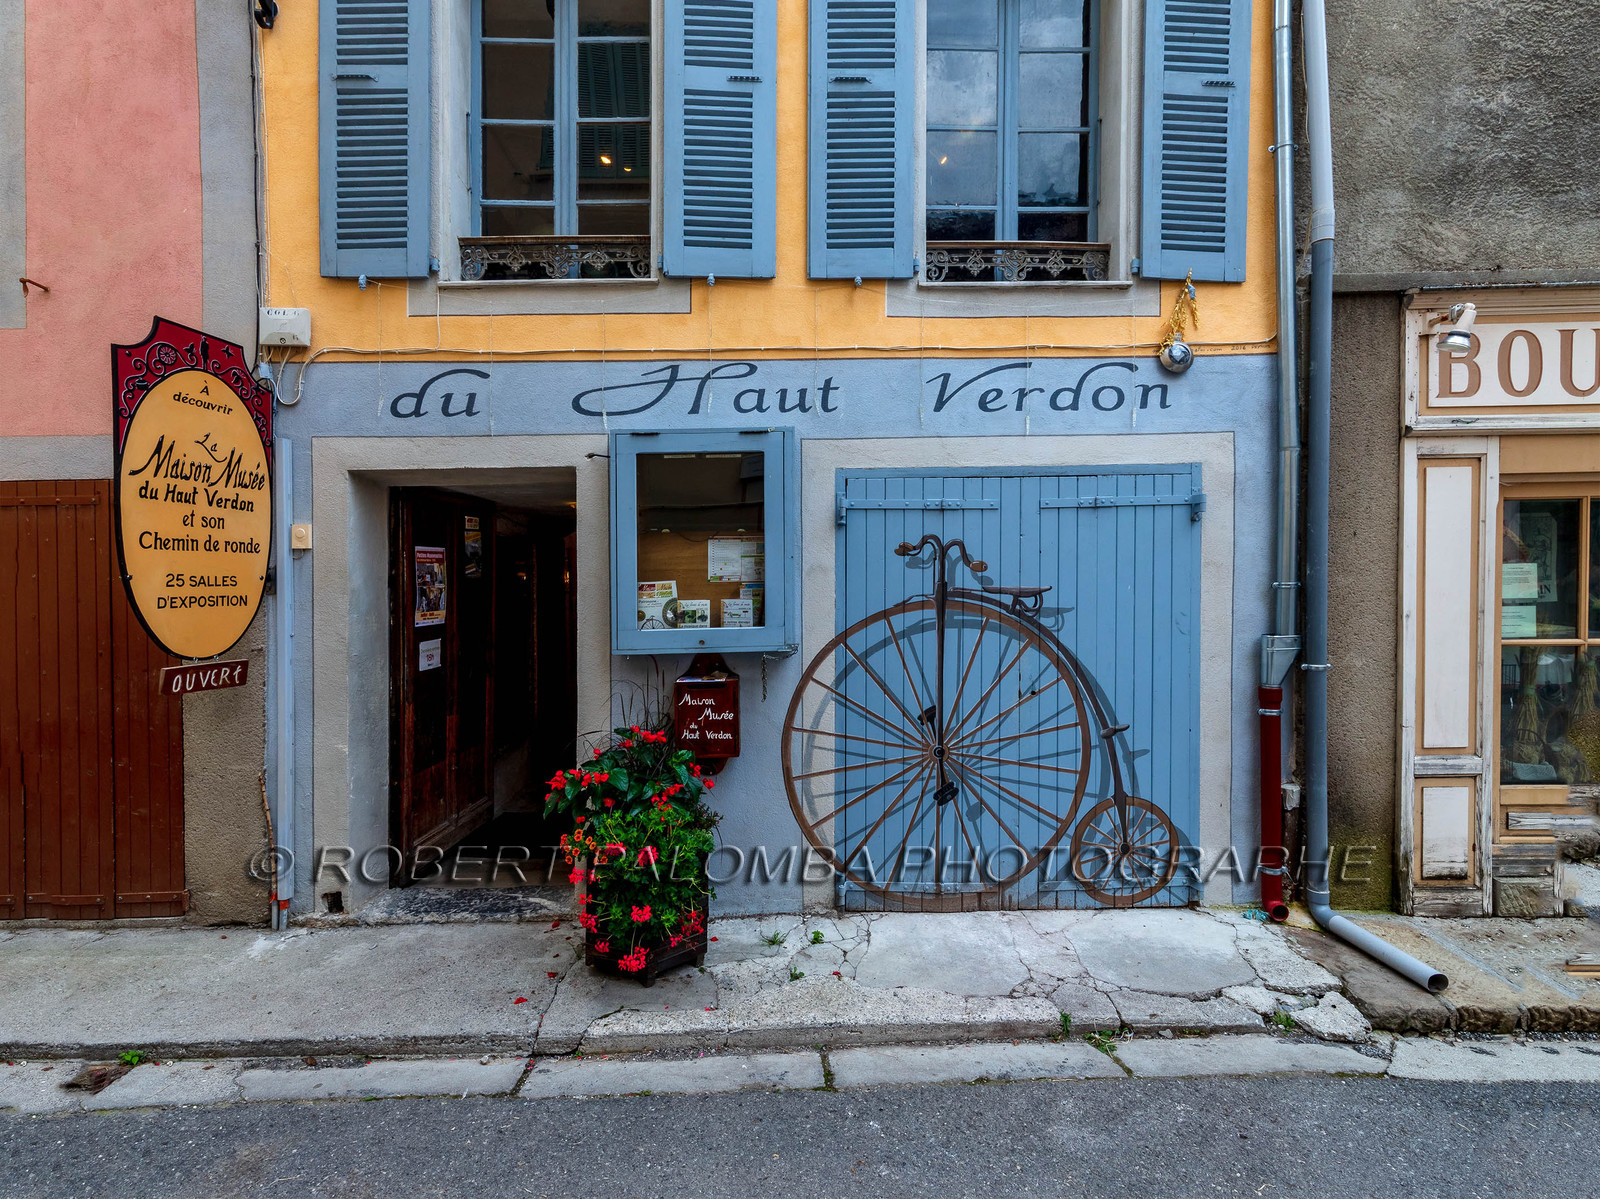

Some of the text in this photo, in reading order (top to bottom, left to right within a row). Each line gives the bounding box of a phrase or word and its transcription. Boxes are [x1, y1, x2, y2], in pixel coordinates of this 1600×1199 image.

[200, 380, 210, 396] À
[389, 361, 1172, 418] du Haut Verdon
[172, 392, 234, 415] découvrir
[194, 432, 228, 463] La
[128, 434, 266, 491] Maison Musée
[138, 480, 255, 512] du Haut Verdon
[182, 510, 225, 529] et son
[138, 531, 261, 554] Chemin de ronde
[165, 573, 238, 588] 25 SALLES
[157, 595, 248, 609] D'EXPOSITION
[678, 693, 715, 706] Maison
[697, 707, 734, 720] Musée
[681, 729, 733, 740] Haut Verdon
